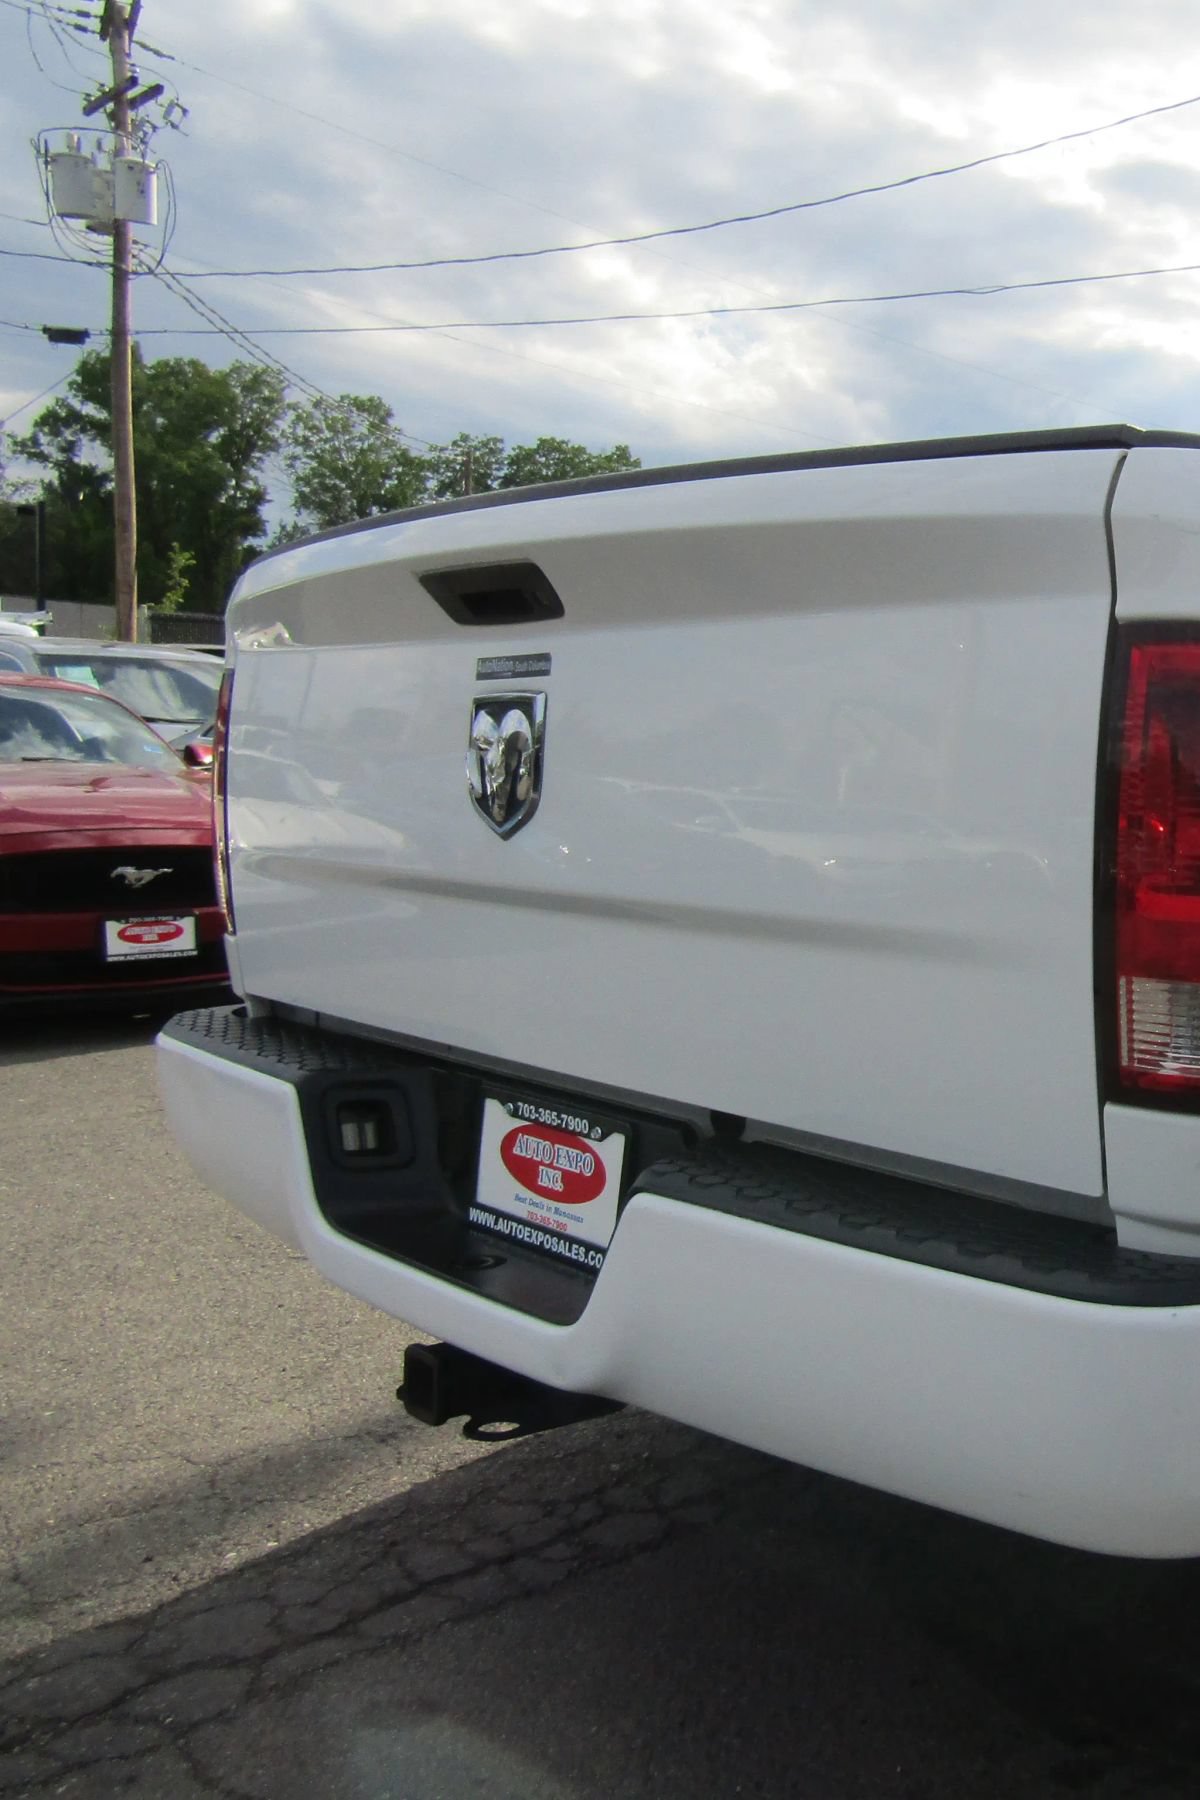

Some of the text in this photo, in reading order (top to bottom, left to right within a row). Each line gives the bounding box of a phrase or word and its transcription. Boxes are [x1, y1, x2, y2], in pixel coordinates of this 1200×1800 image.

[517, 1102, 589, 1134] 703-365-7900
[513, 1133, 595, 1176] AUTO EXPO
[538, 1165, 564, 1192] INC.
[527, 1210, 568, 1232] 703-365-7900
